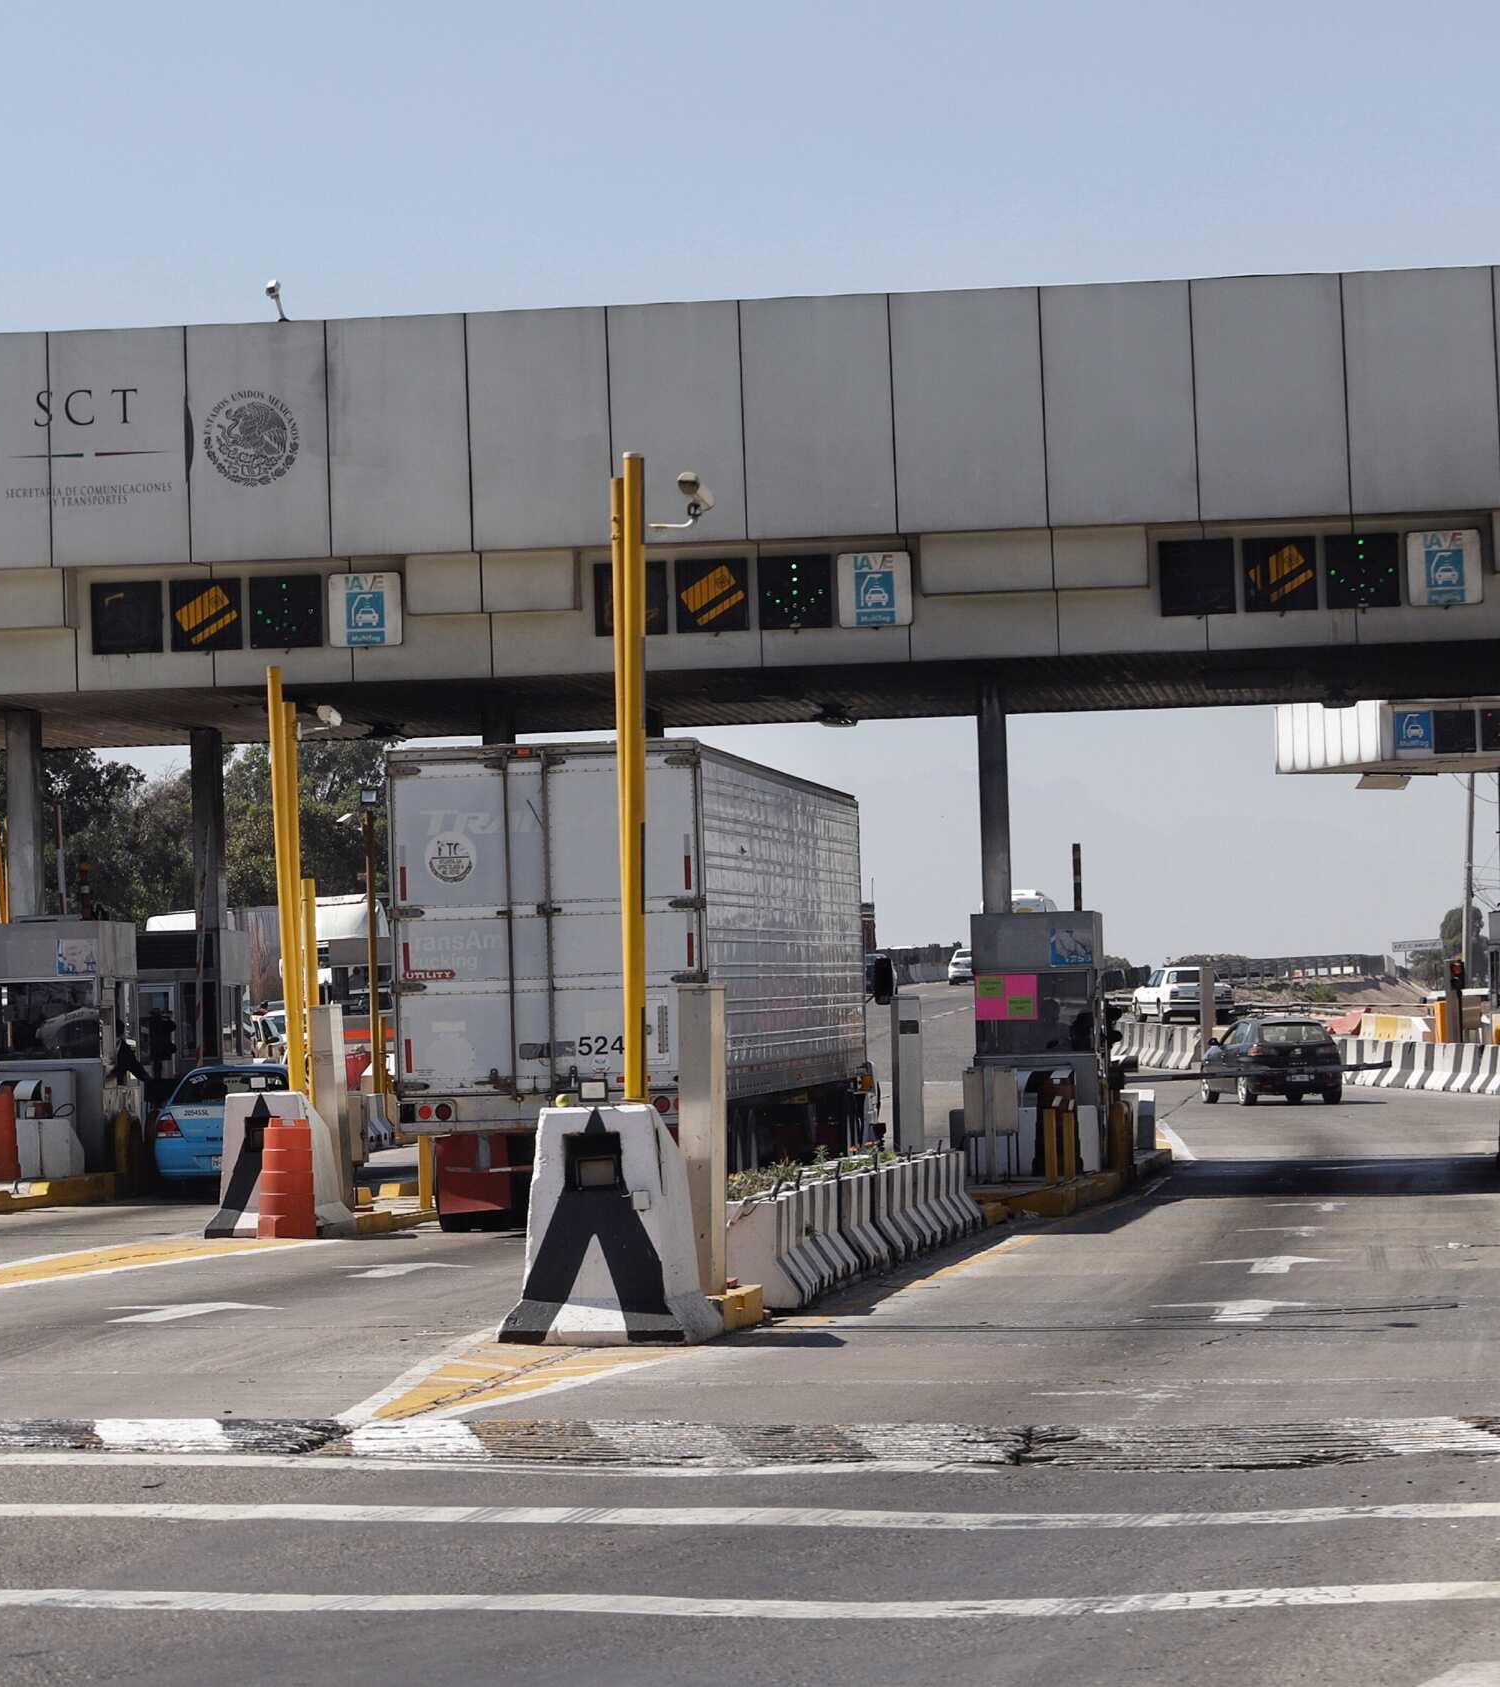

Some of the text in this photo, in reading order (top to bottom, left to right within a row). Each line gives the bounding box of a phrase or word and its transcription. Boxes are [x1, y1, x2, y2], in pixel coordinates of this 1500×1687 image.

[65, 486, 77, 497] DE
[853, 554, 894, 570] IAVE
[344, 575, 385, 591] IAVE
[405, 970, 452, 980] UTILITY
[577, 1035, 625, 1056] 524
